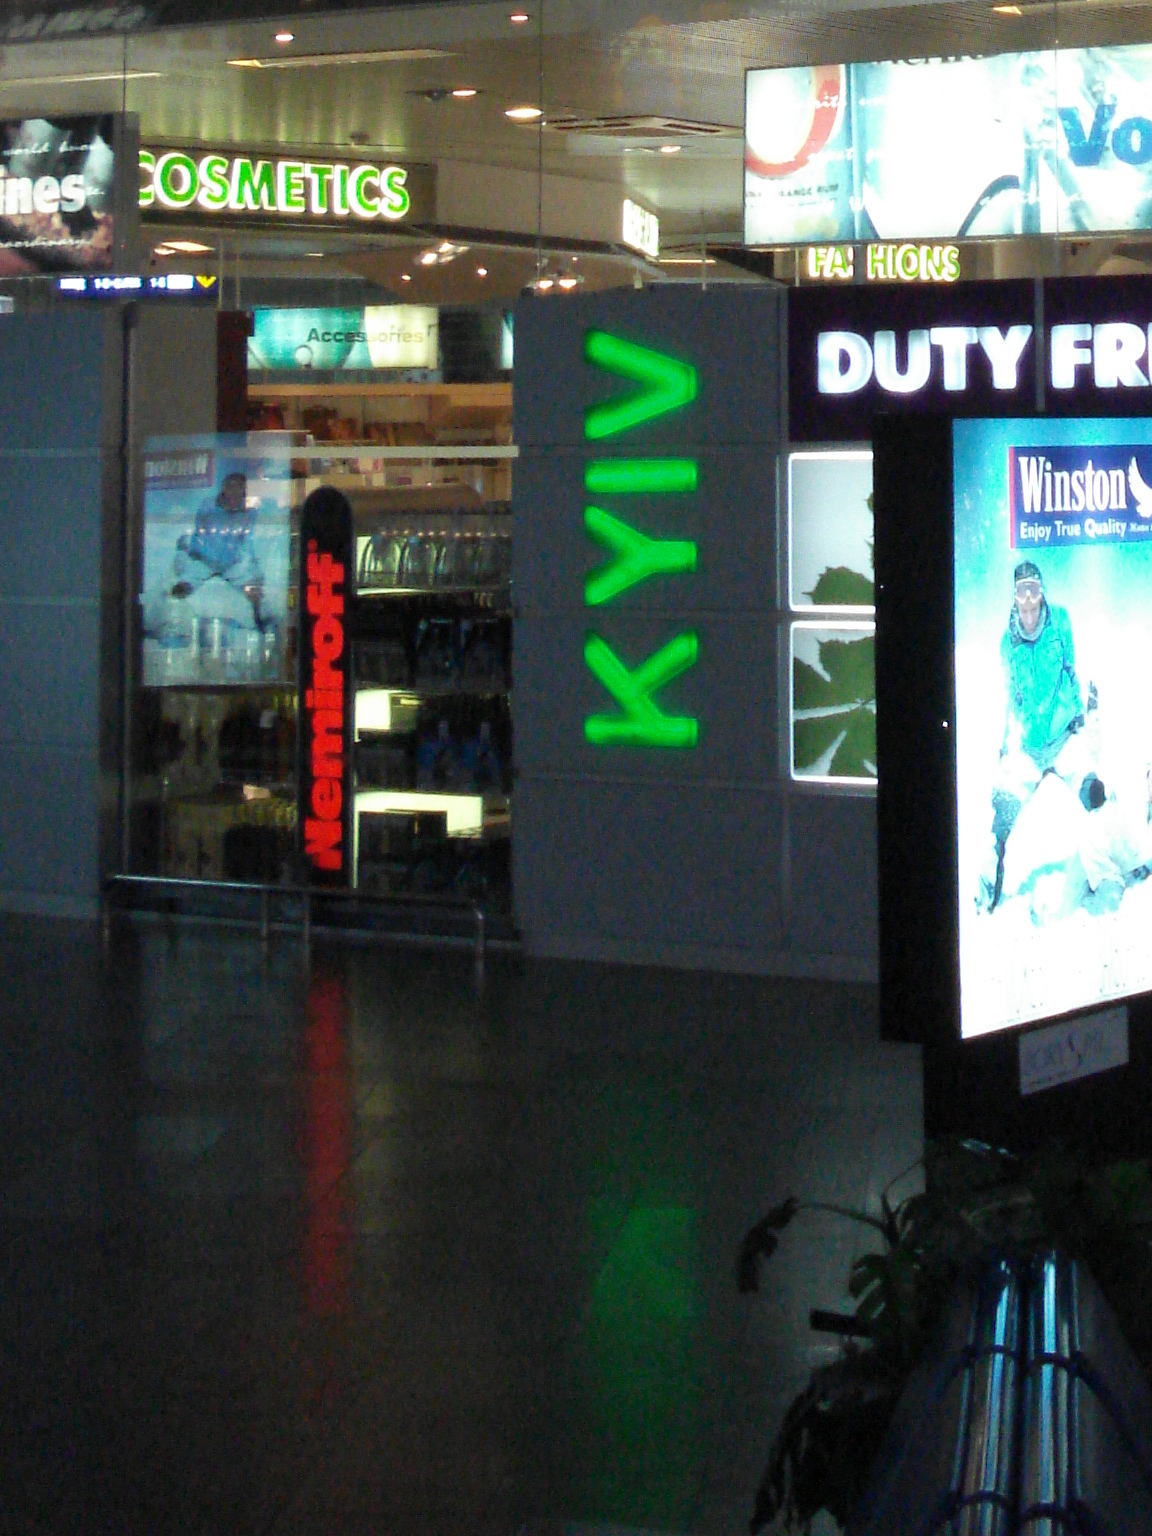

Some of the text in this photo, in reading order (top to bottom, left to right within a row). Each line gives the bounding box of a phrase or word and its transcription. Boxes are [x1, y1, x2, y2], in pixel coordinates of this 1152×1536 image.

[306, 326, 424, 345] Accessories
[817, 324, 1033, 394] DUTY
[1018, 455, 1127, 513] Winston
[585, 331, 698, 747] KYIV
[1020, 521, 1052, 542] Enjoy
[1054, 519, 1081, 537] True
[1084, 517, 1128, 539] Quality
[304, 550, 345, 871] Nemiroff
